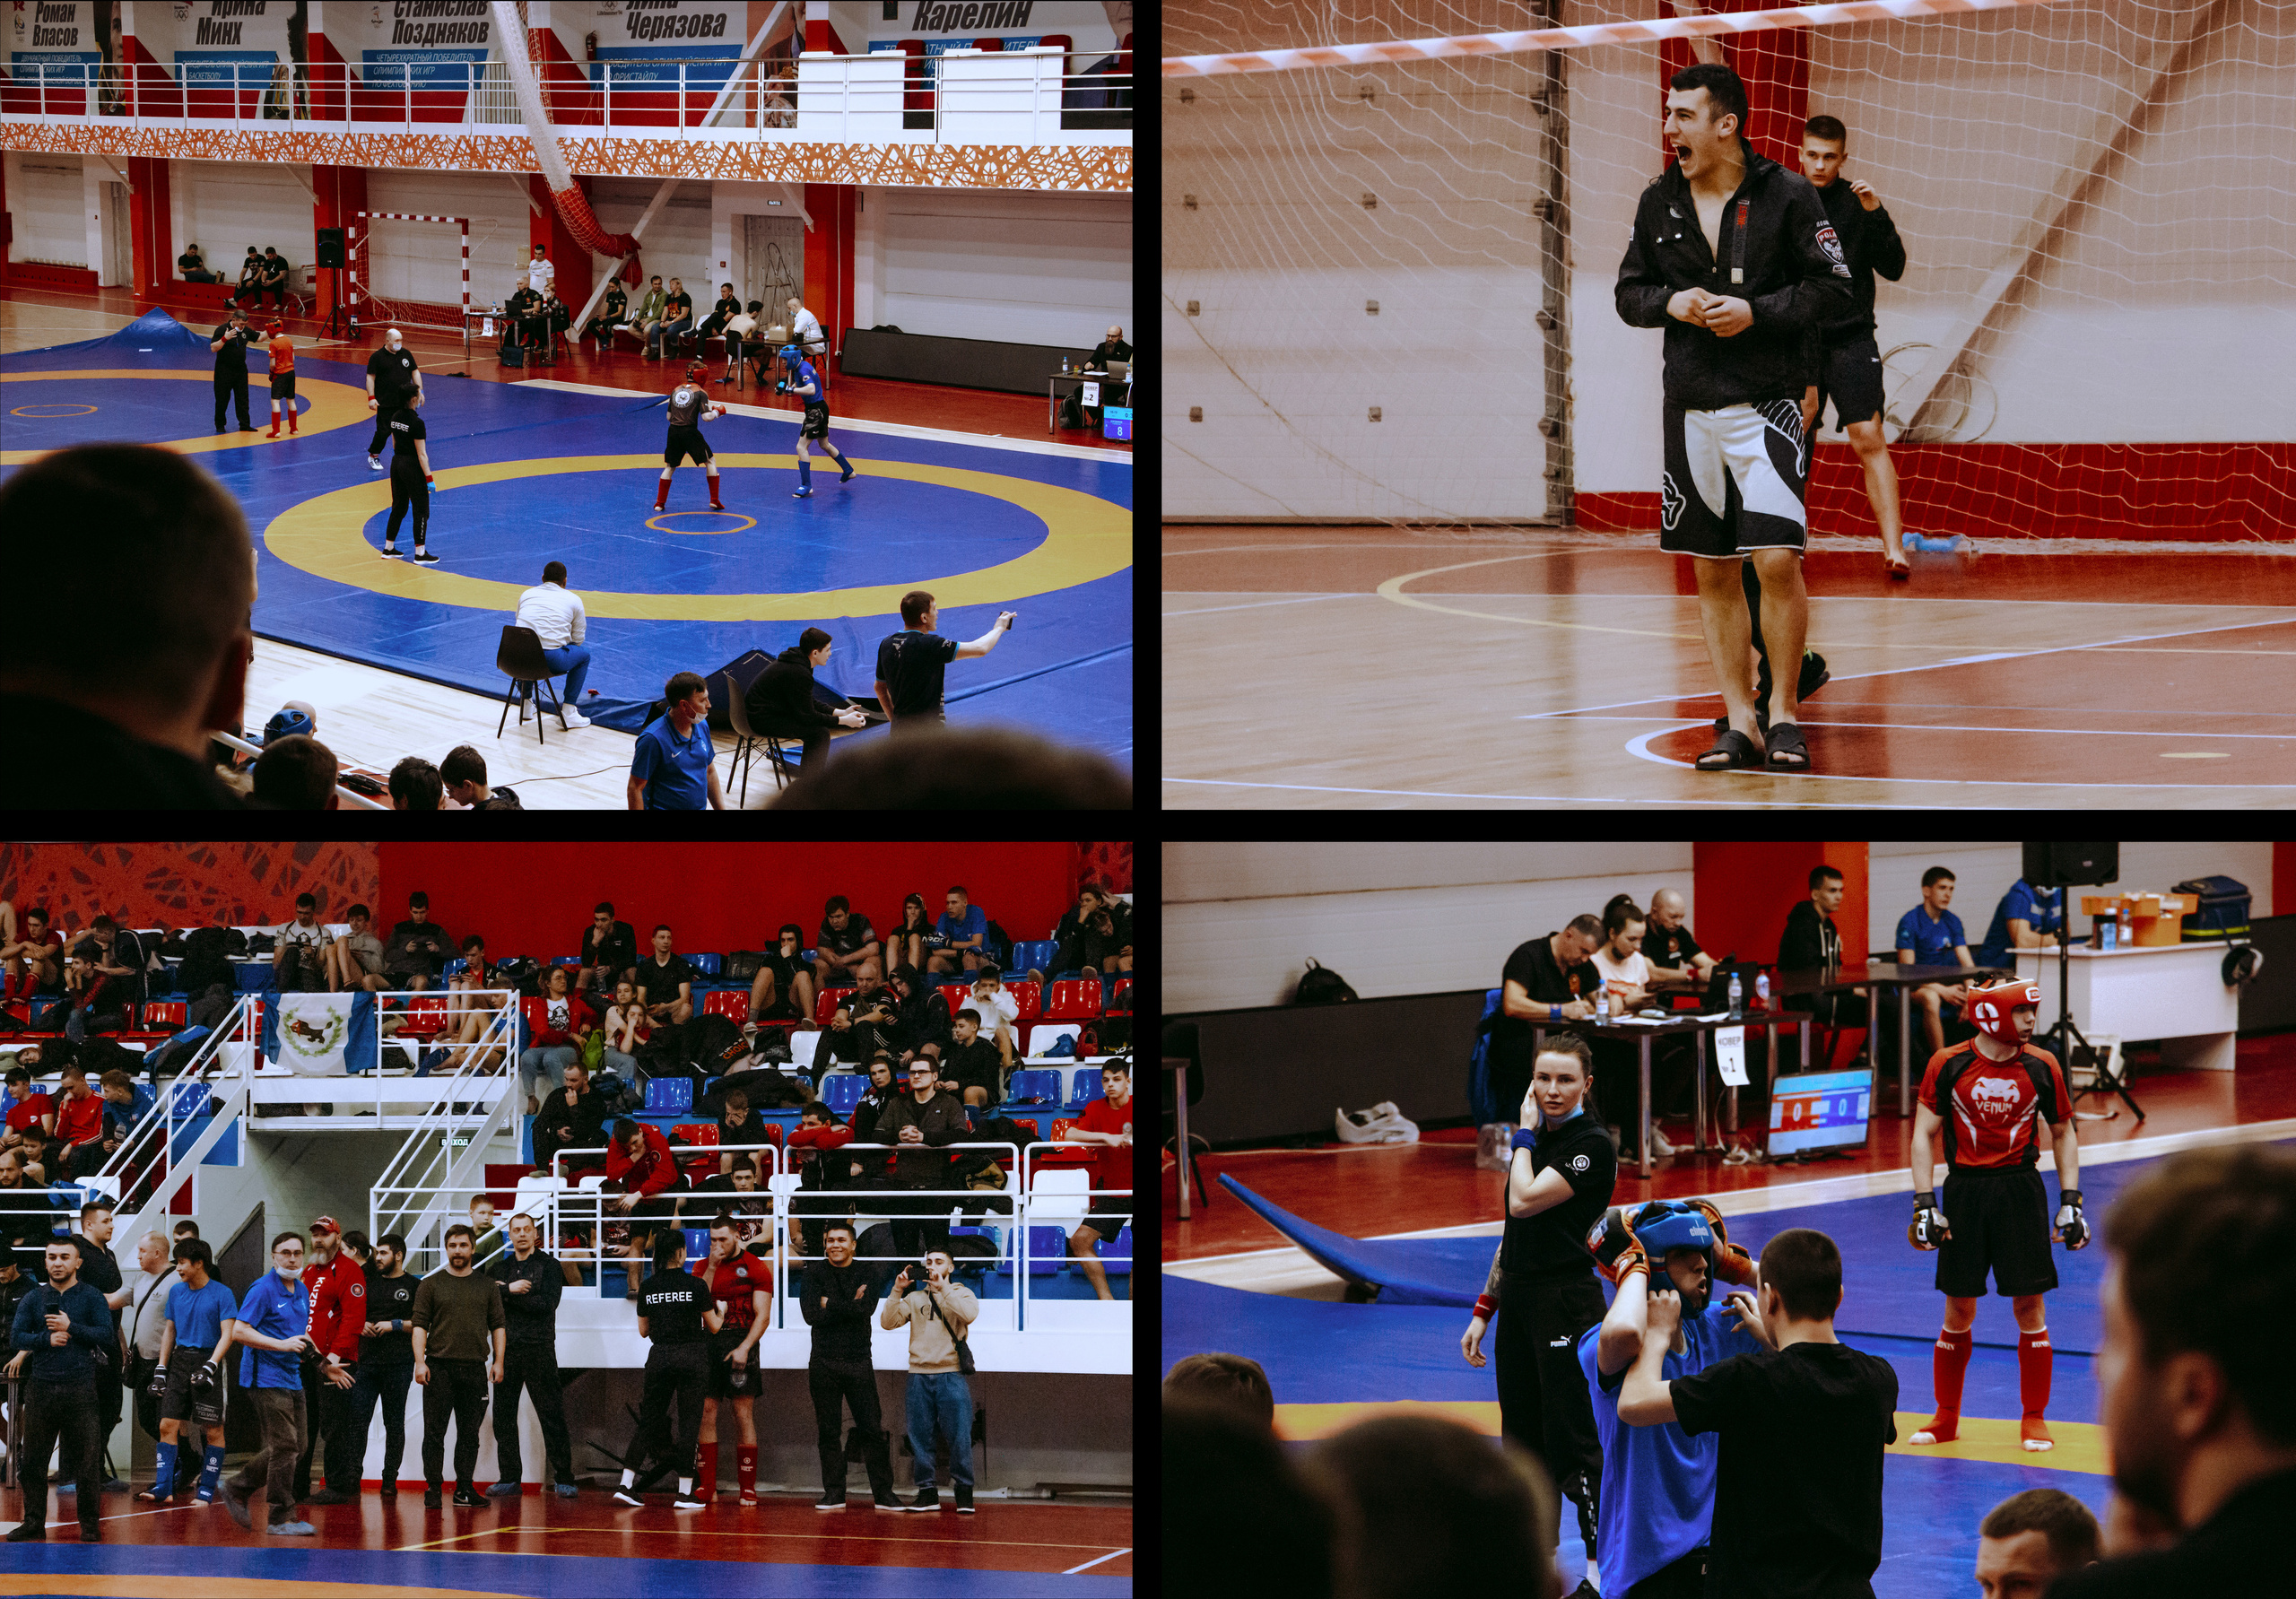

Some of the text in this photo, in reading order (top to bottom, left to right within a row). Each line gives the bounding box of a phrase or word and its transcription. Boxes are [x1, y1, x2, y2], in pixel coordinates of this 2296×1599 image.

[35, 1, 76, 23] Роман
[911, 1, 1033, 33] Карелин
[32, 24, 79, 47] Власов
[196, 17, 243, 45] Минх
[392, 19, 490, 48] Поздняков
[626, 11, 727, 41] Черязова
[377, 52, 475, 62] ЧЕТЫРЕХКРАТНЫЙ ПОБЕДИТЕЛЬ
[373, 65, 436, 75] ОЛИМПИЙКИХ ИГР
[1118, 426, 1123, 437] 8
[1793, 1098, 1848, 1122] 0 0
[1975, 1100, 2013, 1115] VENUM
[646, 1291, 693, 1305] REFEREE
